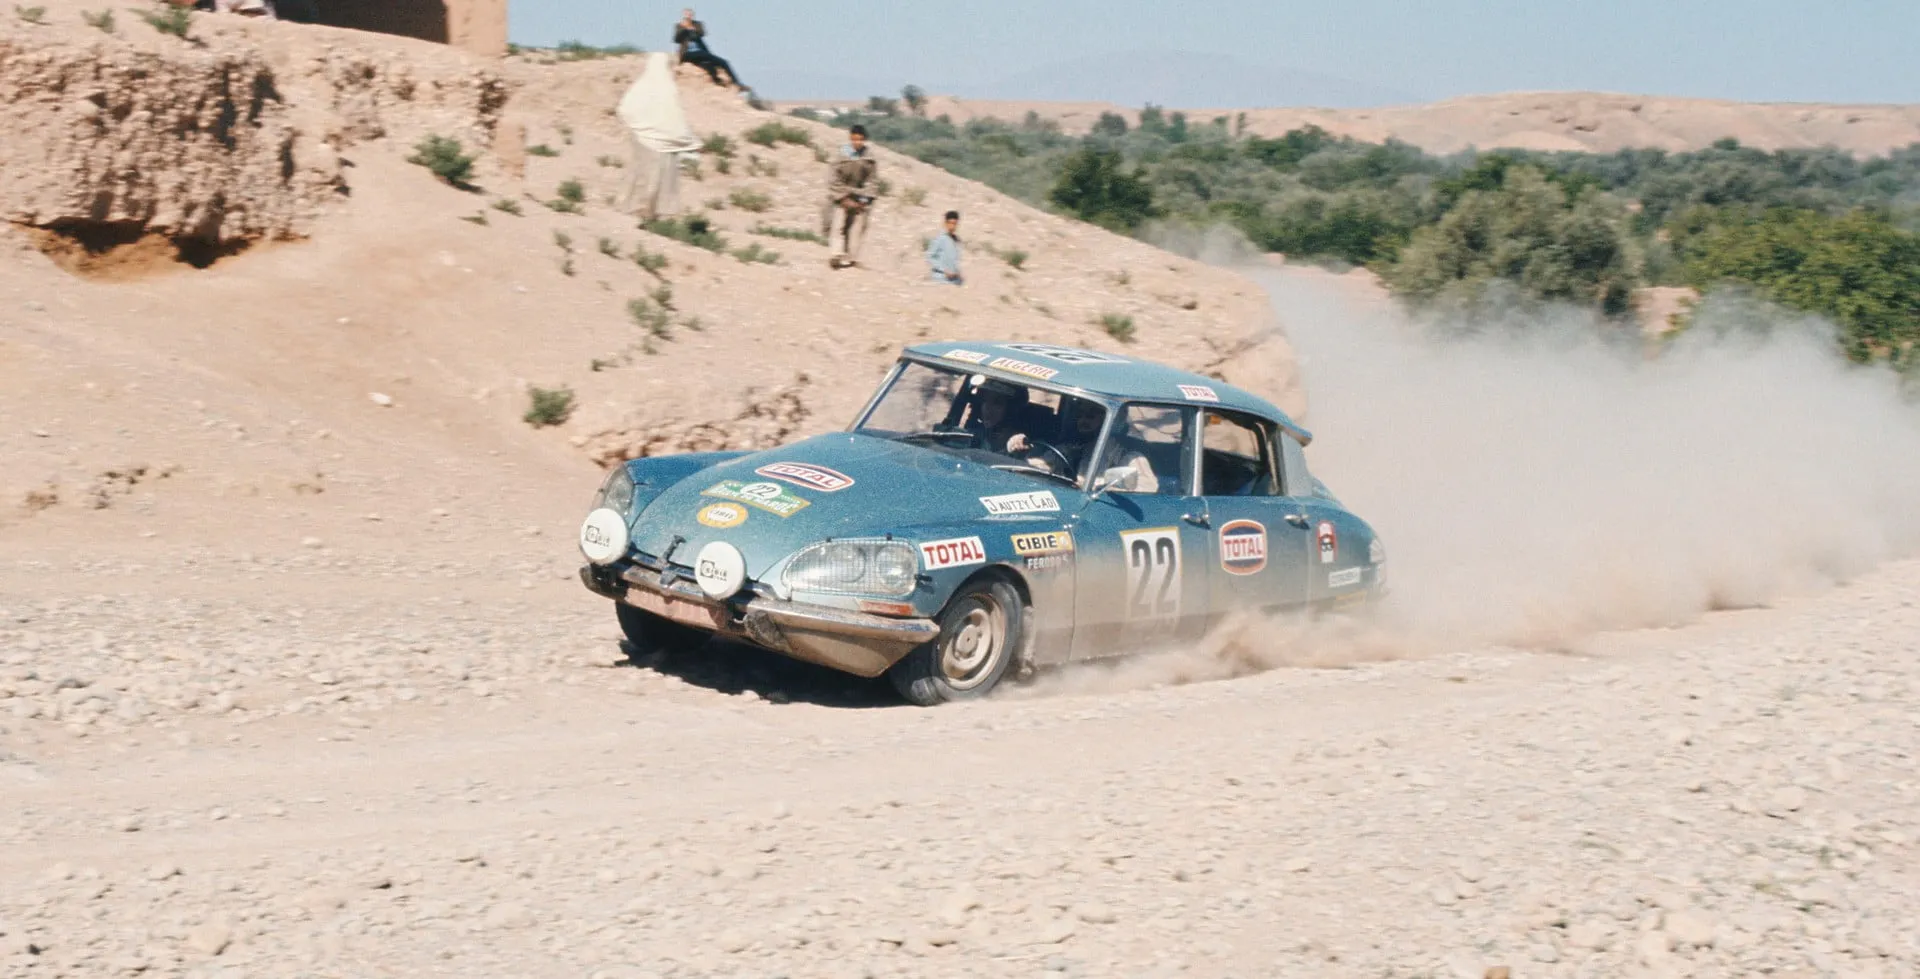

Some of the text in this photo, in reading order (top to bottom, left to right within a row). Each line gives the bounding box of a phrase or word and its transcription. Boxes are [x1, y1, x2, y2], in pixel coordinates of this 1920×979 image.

[772, 465, 836, 486] TOTAL
[746, 484, 777, 496] 22
[923, 540, 984, 566] TOTAL
[1224, 537, 1262, 558] TOTAL
[1131, 537, 1177, 618] 22
